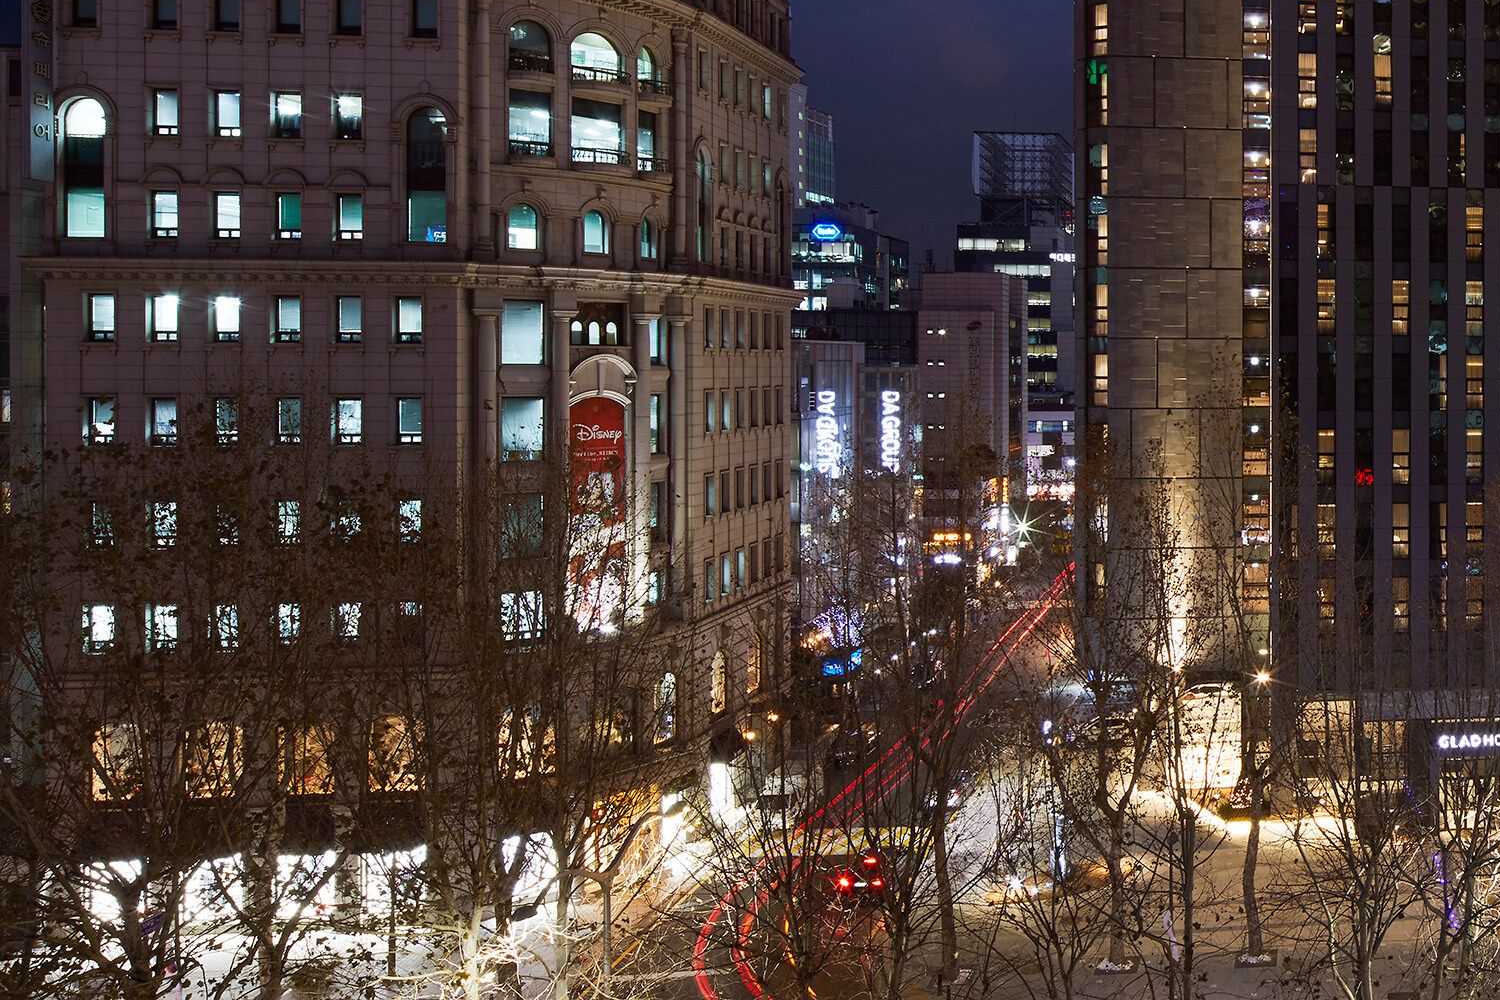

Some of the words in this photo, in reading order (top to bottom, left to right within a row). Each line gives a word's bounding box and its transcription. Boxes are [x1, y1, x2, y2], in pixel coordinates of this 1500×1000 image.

[33, 31, 50, 141] 슈페리어
[817, 391, 835, 416] DA
[882, 391, 900, 415] DA
[881, 416, 900, 474] GROUP
[1438, 734, 1481, 749] GLAD
